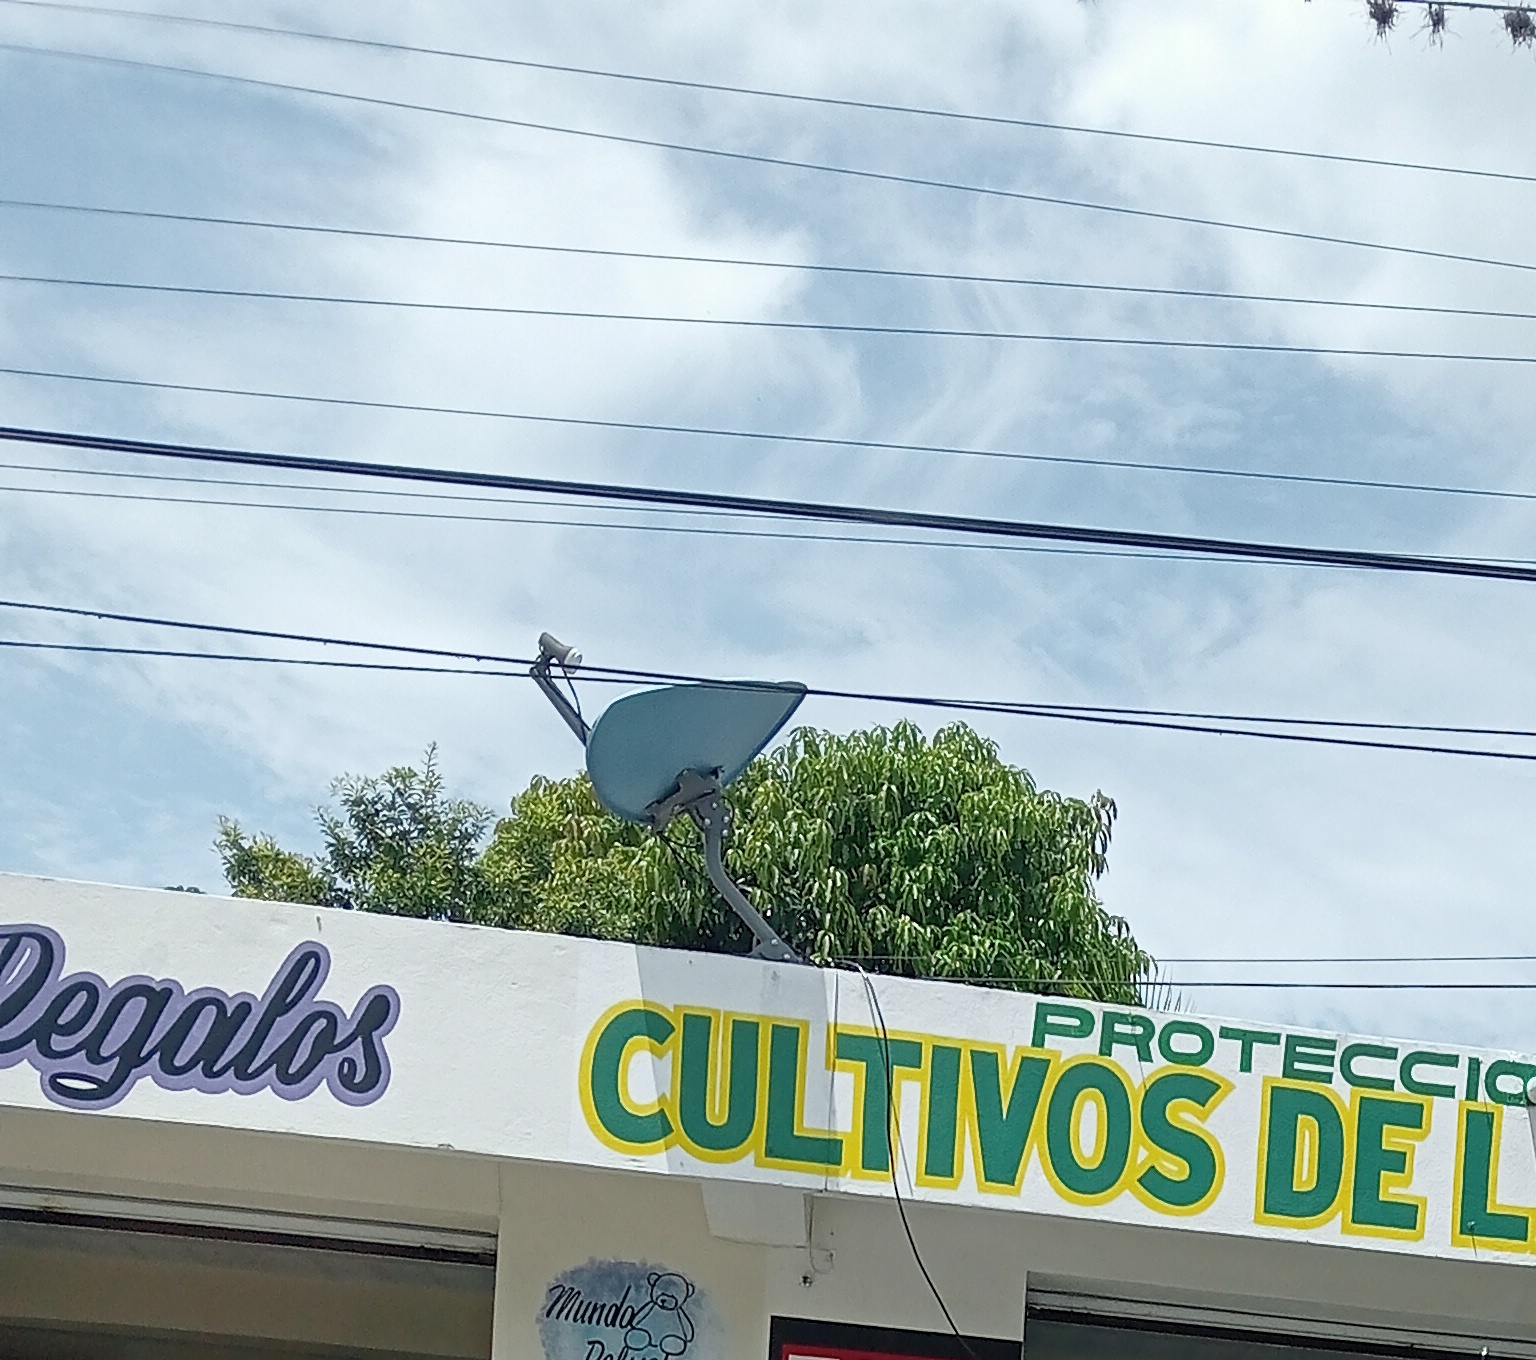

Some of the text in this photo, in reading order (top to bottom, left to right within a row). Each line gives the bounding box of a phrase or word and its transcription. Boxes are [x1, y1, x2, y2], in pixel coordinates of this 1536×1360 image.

[580, 1000, 1234, 1216] CULTIVOS
[1255, 1076, 1431, 1240] DE
[546, 1284, 636, 1329] Mundo
